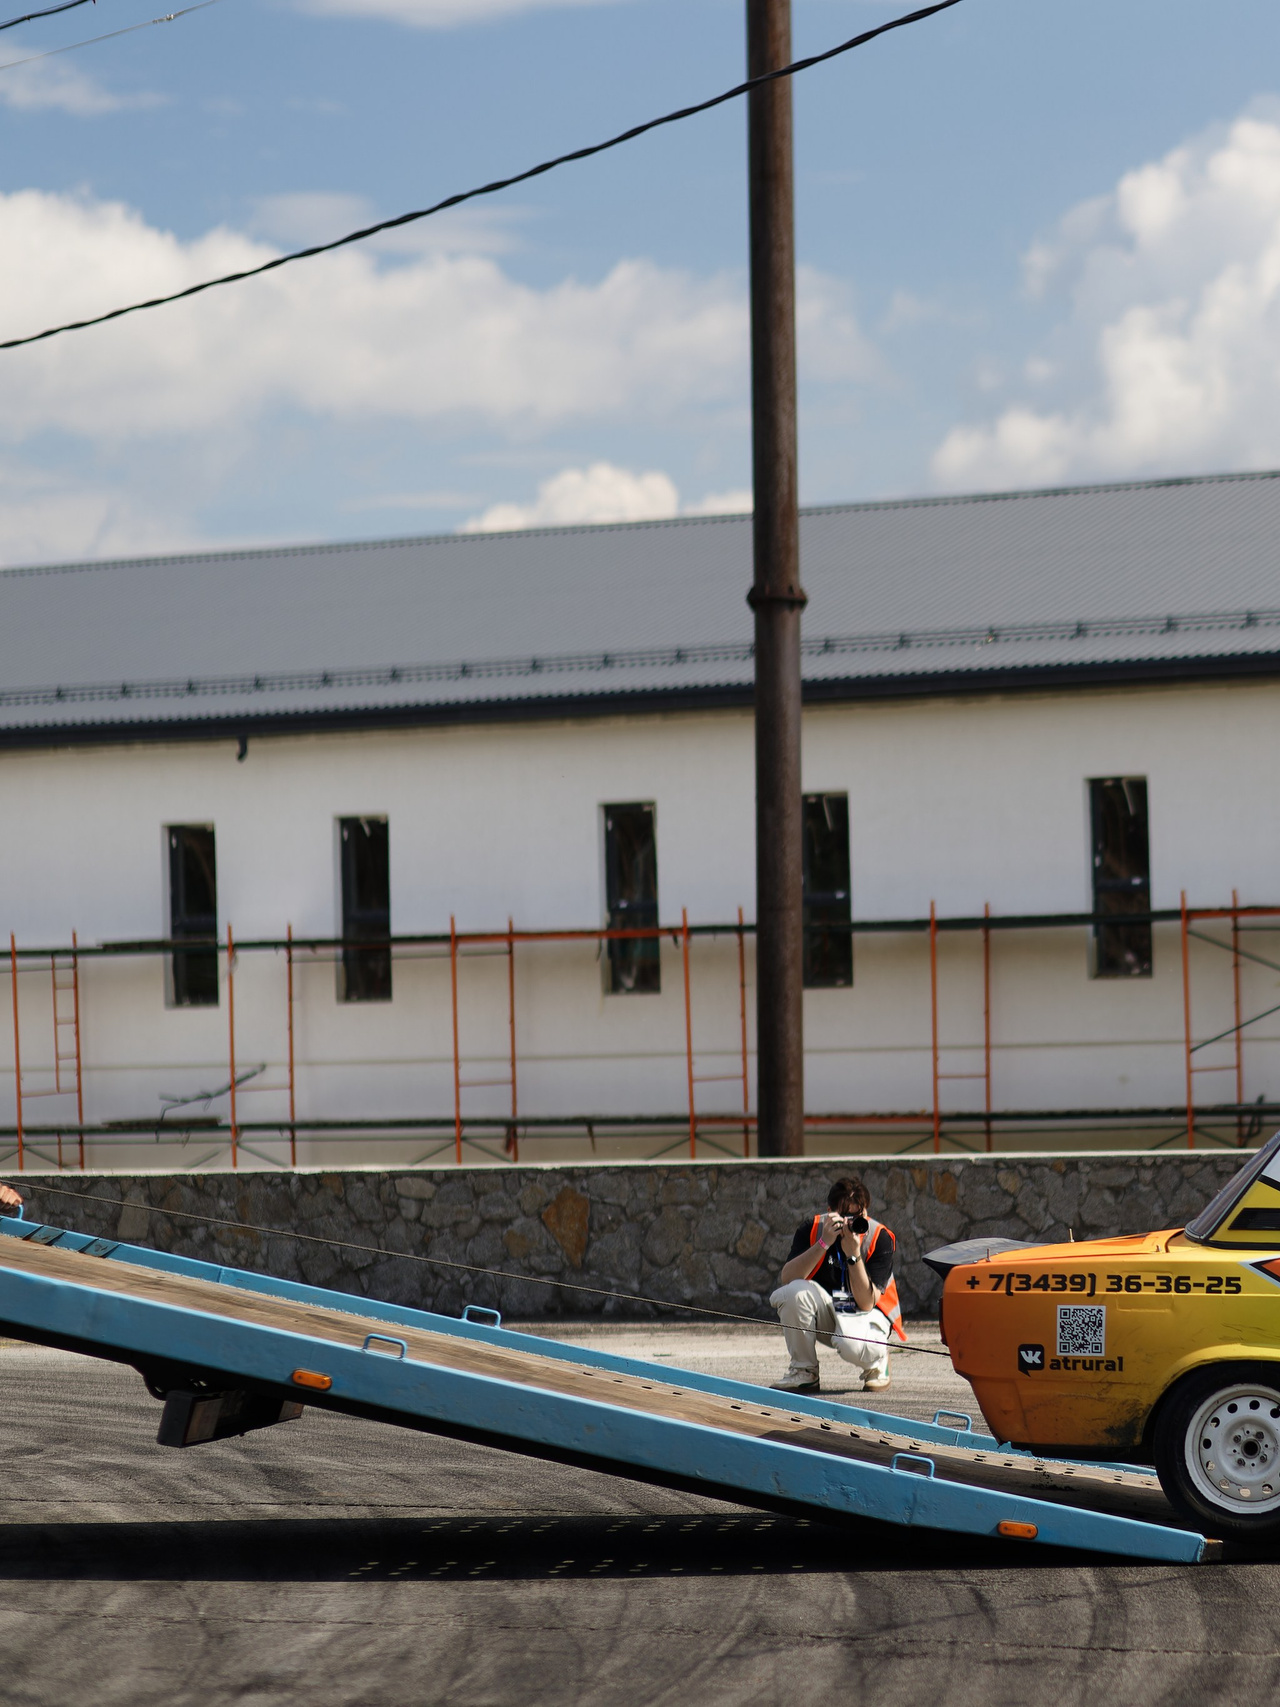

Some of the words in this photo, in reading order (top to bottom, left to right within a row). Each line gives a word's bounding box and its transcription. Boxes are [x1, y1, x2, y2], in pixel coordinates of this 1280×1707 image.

[1105, 1274, 1242, 1295] 36-36-25
[1020, 1350, 1043, 1364] VK
[1048, 1356, 1124, 1372] atrural
